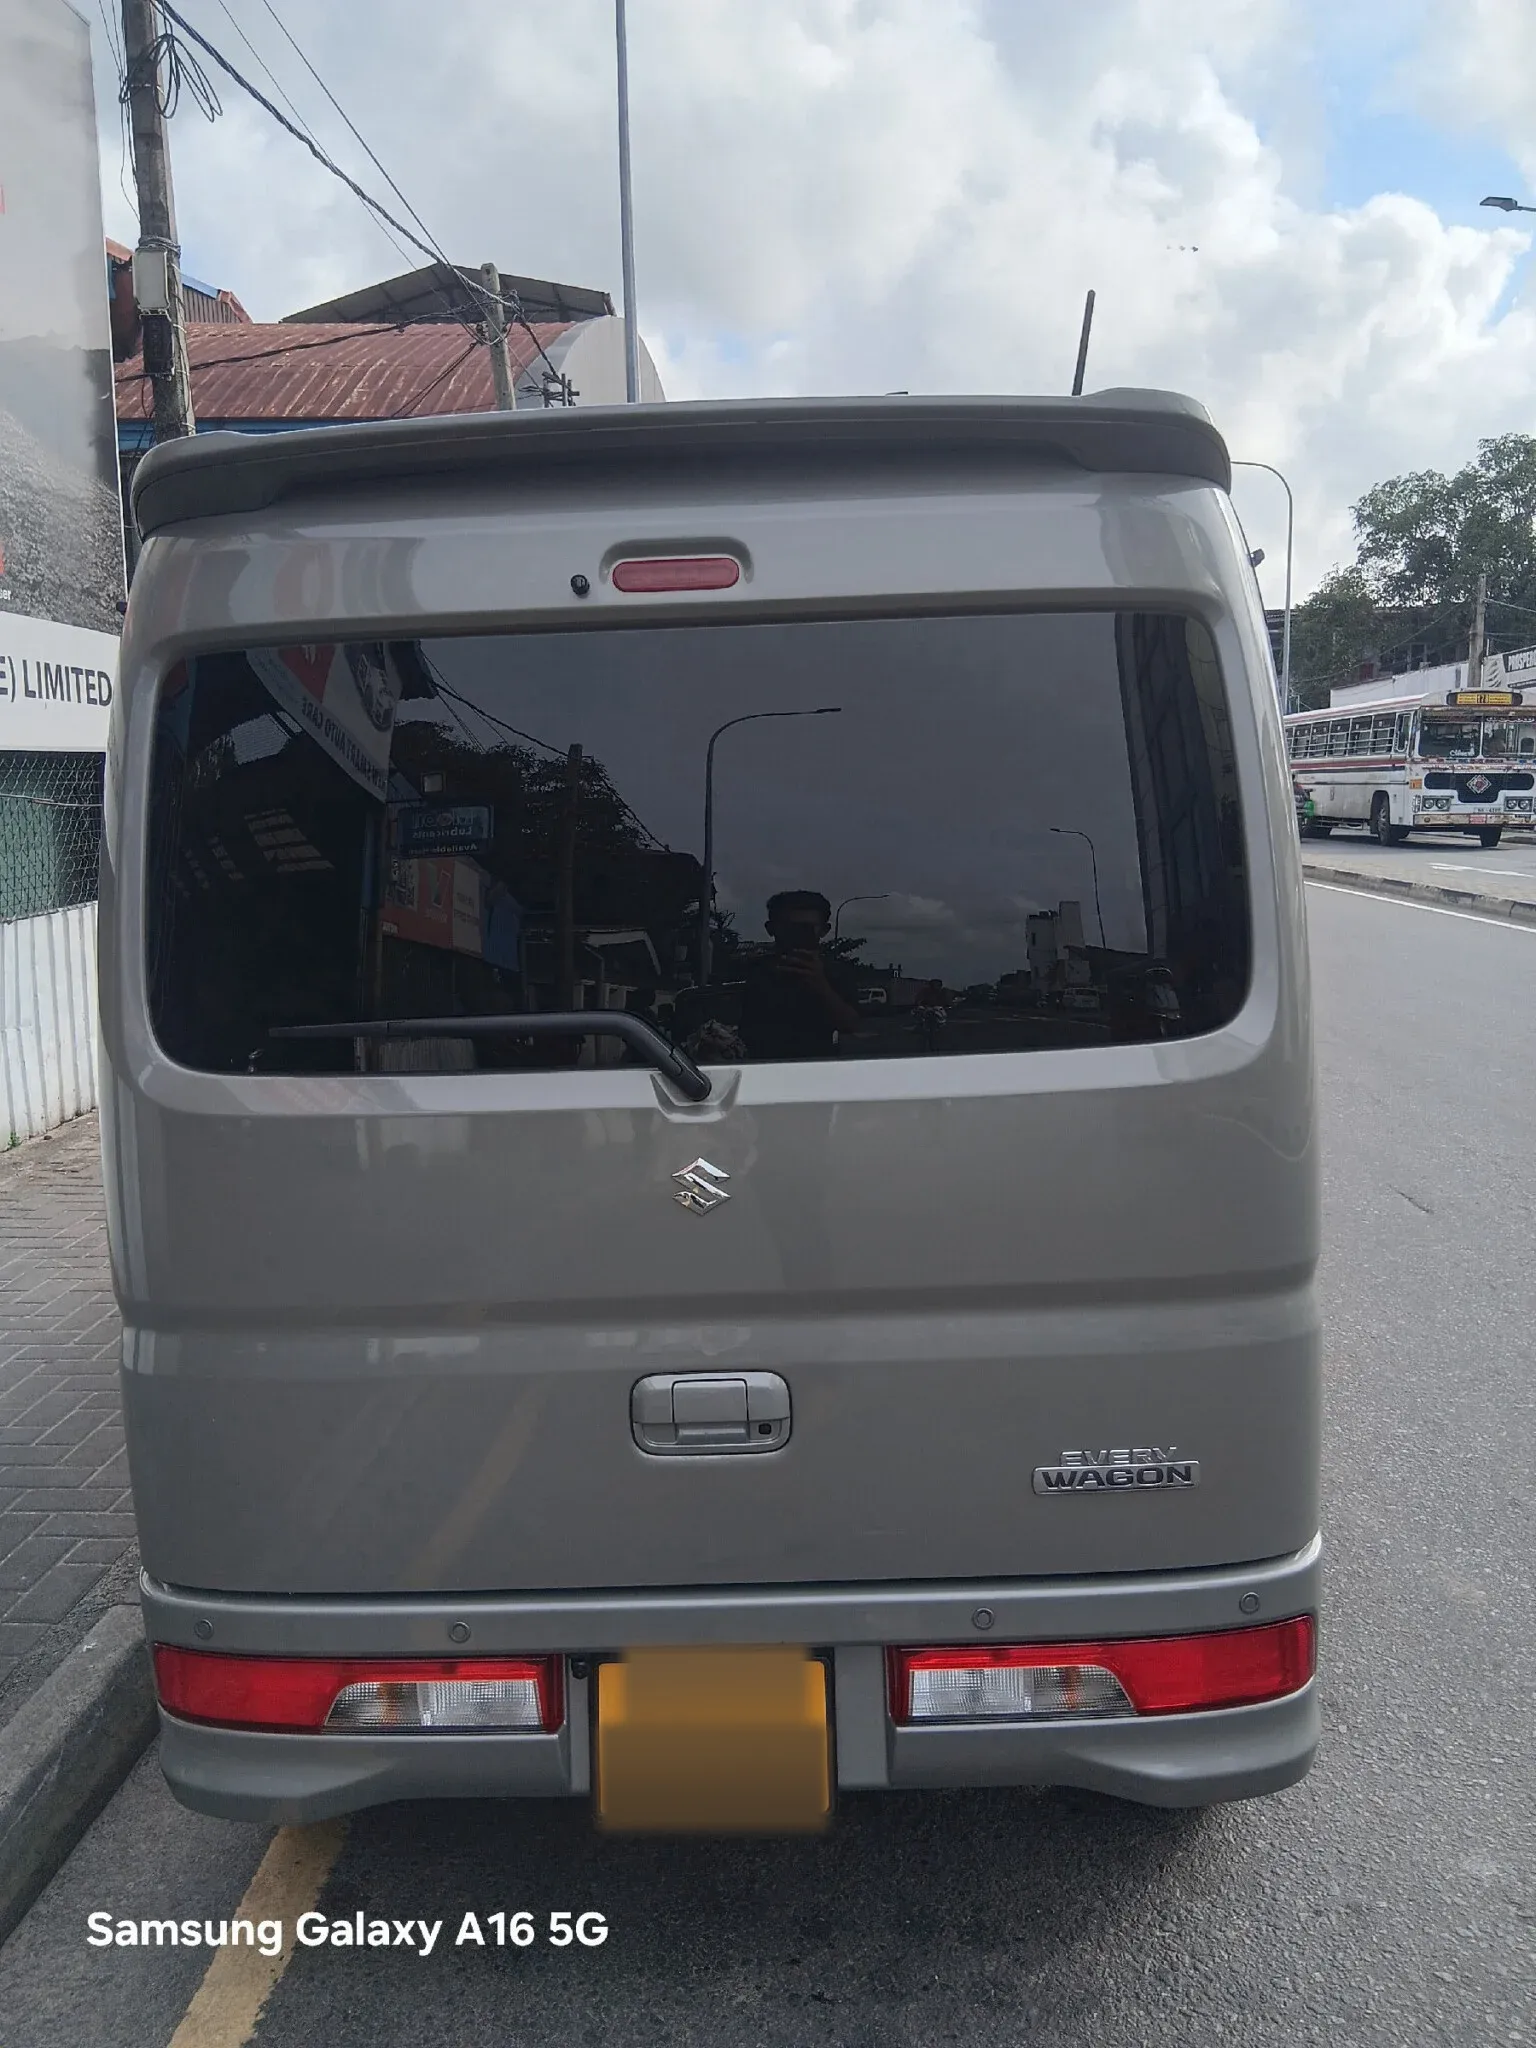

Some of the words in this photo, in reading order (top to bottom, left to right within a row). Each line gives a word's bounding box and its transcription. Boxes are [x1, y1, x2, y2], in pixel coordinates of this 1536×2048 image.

[22, 659, 113, 707] LIMITED
[1059, 1446, 1177, 1467] EVERY
[1041, 1465, 1192, 1490] WAGON
